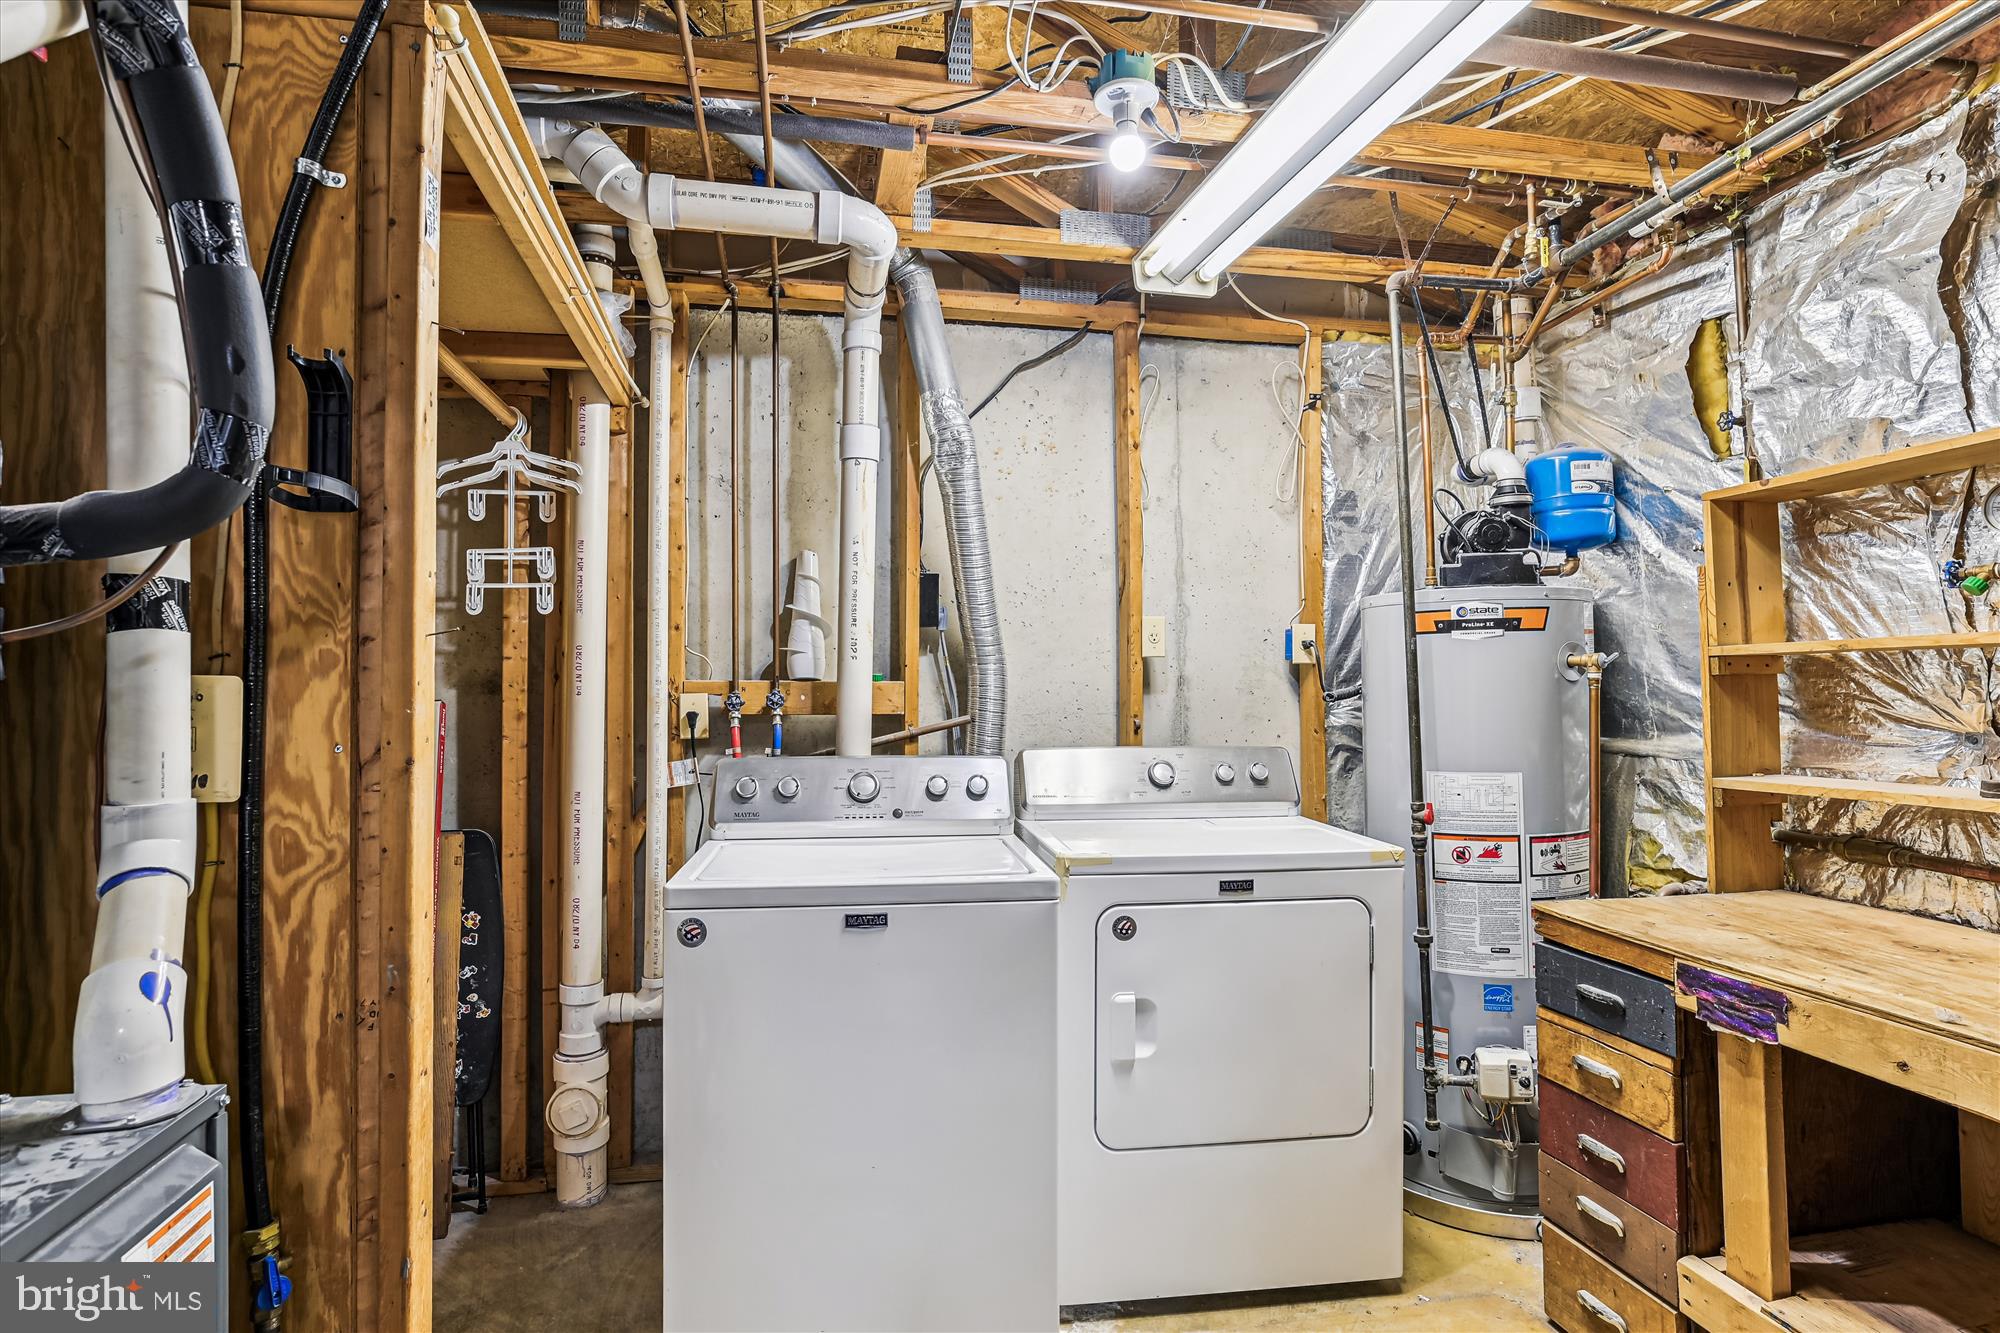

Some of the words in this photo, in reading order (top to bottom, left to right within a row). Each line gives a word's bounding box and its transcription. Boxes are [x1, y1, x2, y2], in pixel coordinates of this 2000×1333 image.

[850, 589, 858, 627] PRESSURE
[1220, 881, 1252, 890] MAYTAG
[847, 915, 886, 925] MAYTAG
